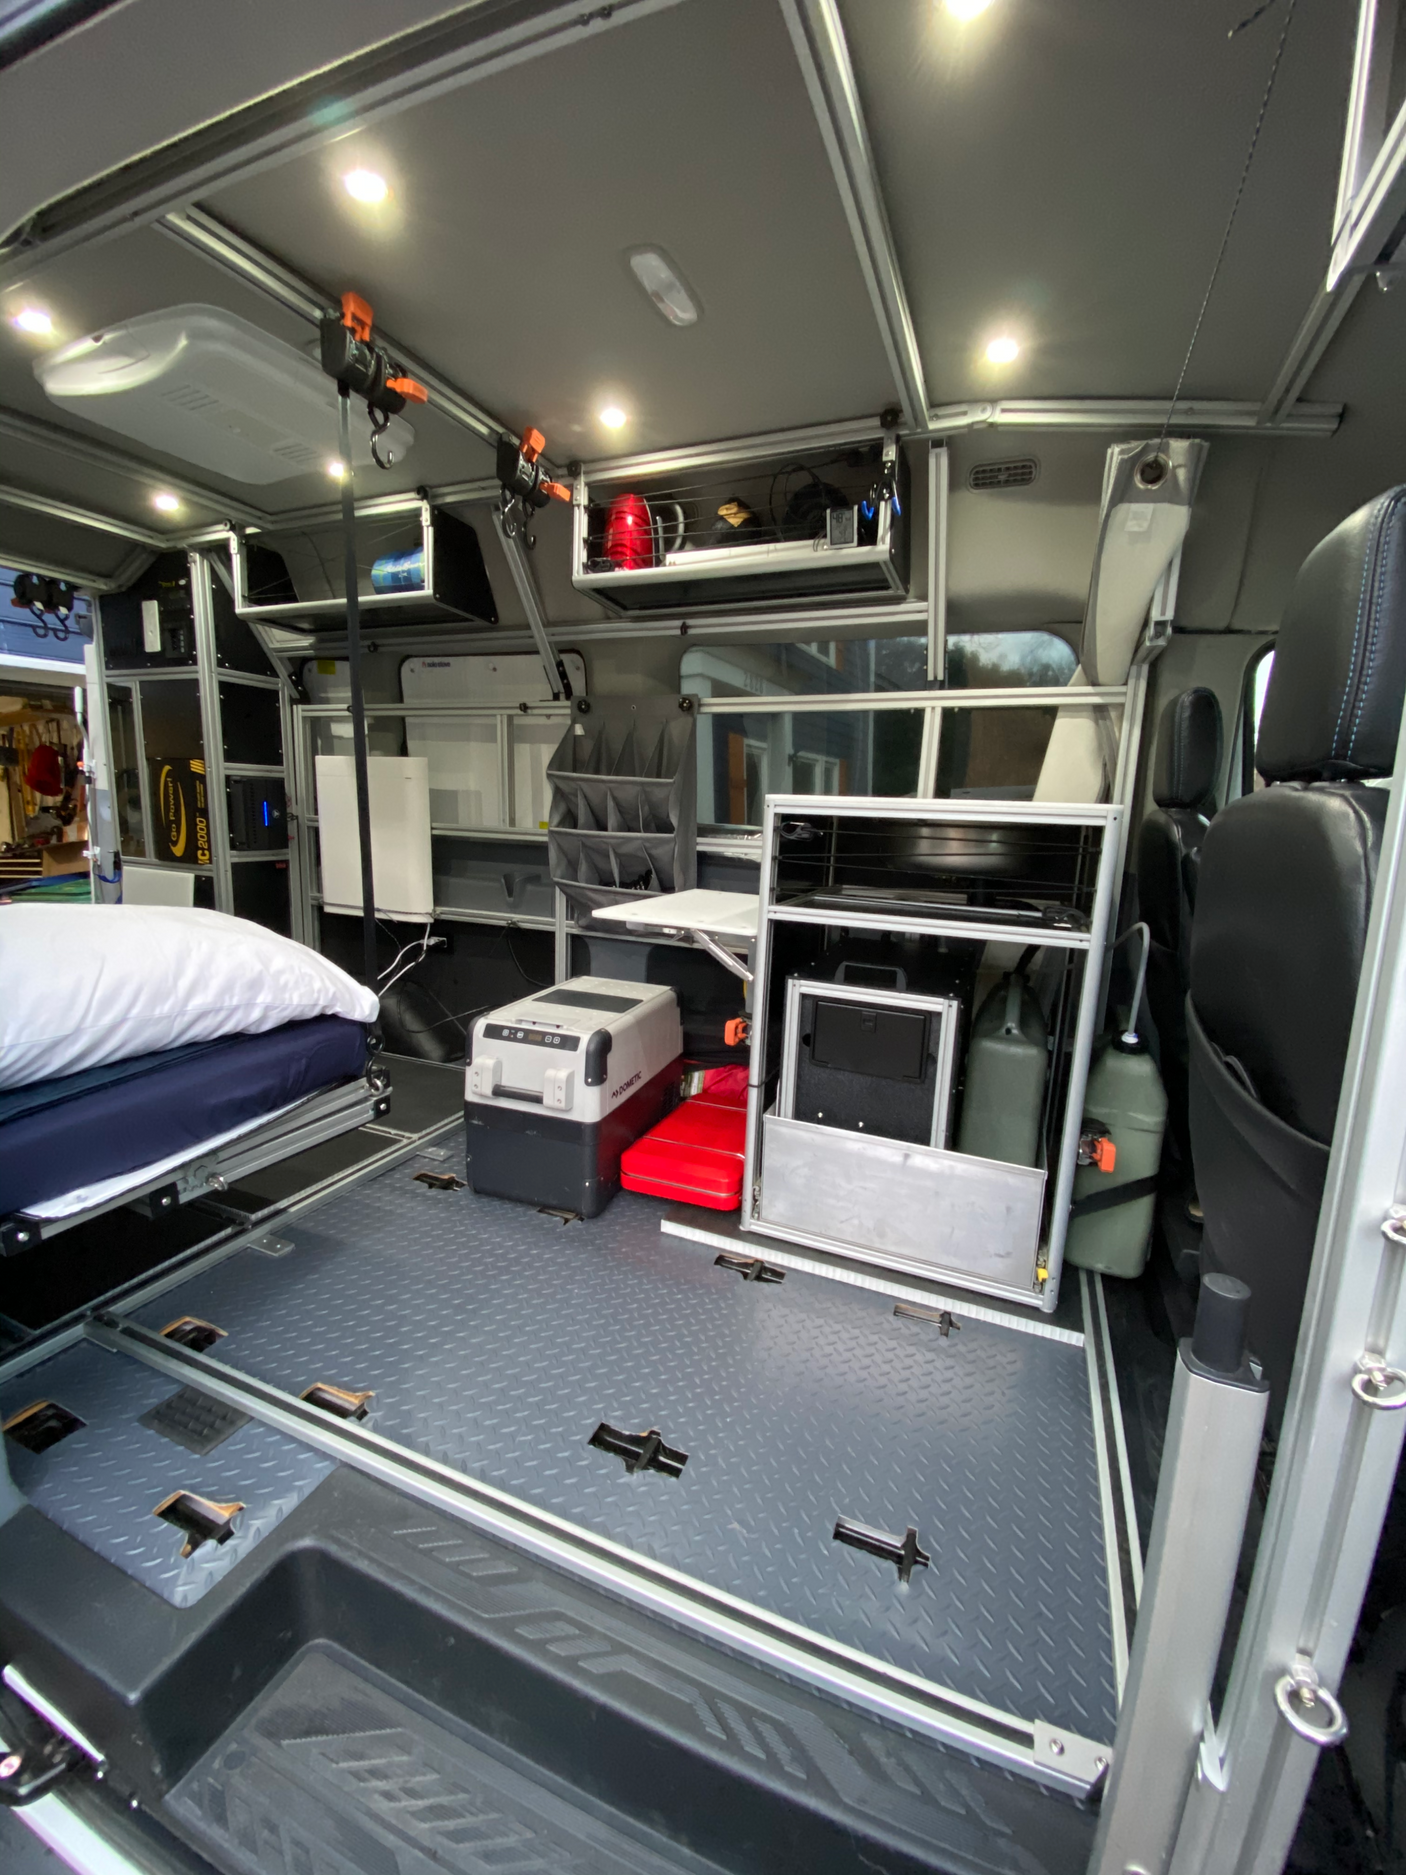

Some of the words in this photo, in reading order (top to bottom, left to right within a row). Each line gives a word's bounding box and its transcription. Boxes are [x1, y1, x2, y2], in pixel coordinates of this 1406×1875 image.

[166, 777, 175, 820] Power!
[170, 824, 177, 841] Go
[196, 818, 208, 849] 2000
[619, 1070, 642, 1095] DOMETIC
